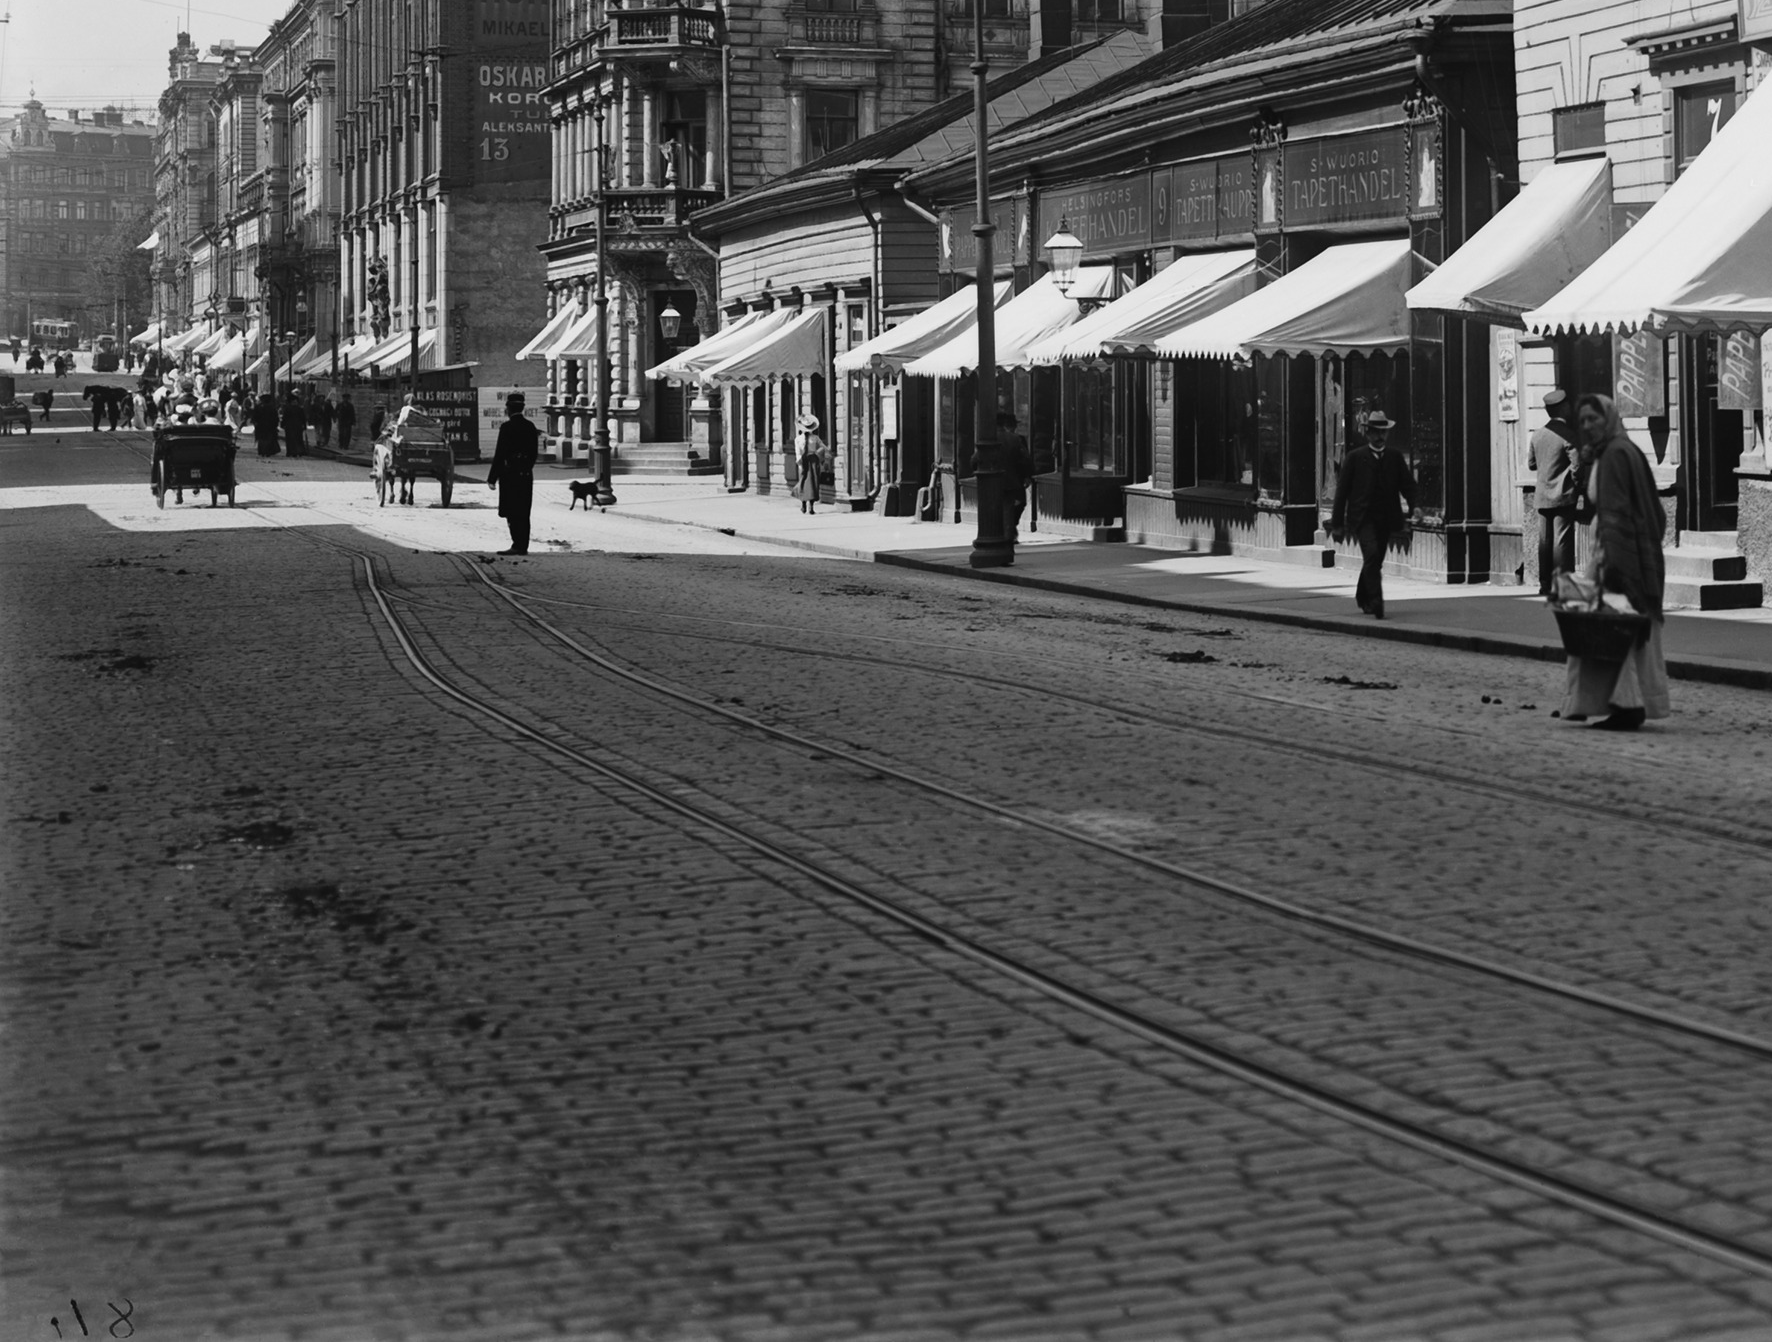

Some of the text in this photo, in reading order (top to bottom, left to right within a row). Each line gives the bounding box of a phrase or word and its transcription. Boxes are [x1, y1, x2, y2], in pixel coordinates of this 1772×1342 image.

[479, 64, 547, 88] OSKAR
[479, 136, 510, 161] 13
[1290, 167, 1401, 211] TAPETHANDEL
[1158, 186, 1167, 226] 9
